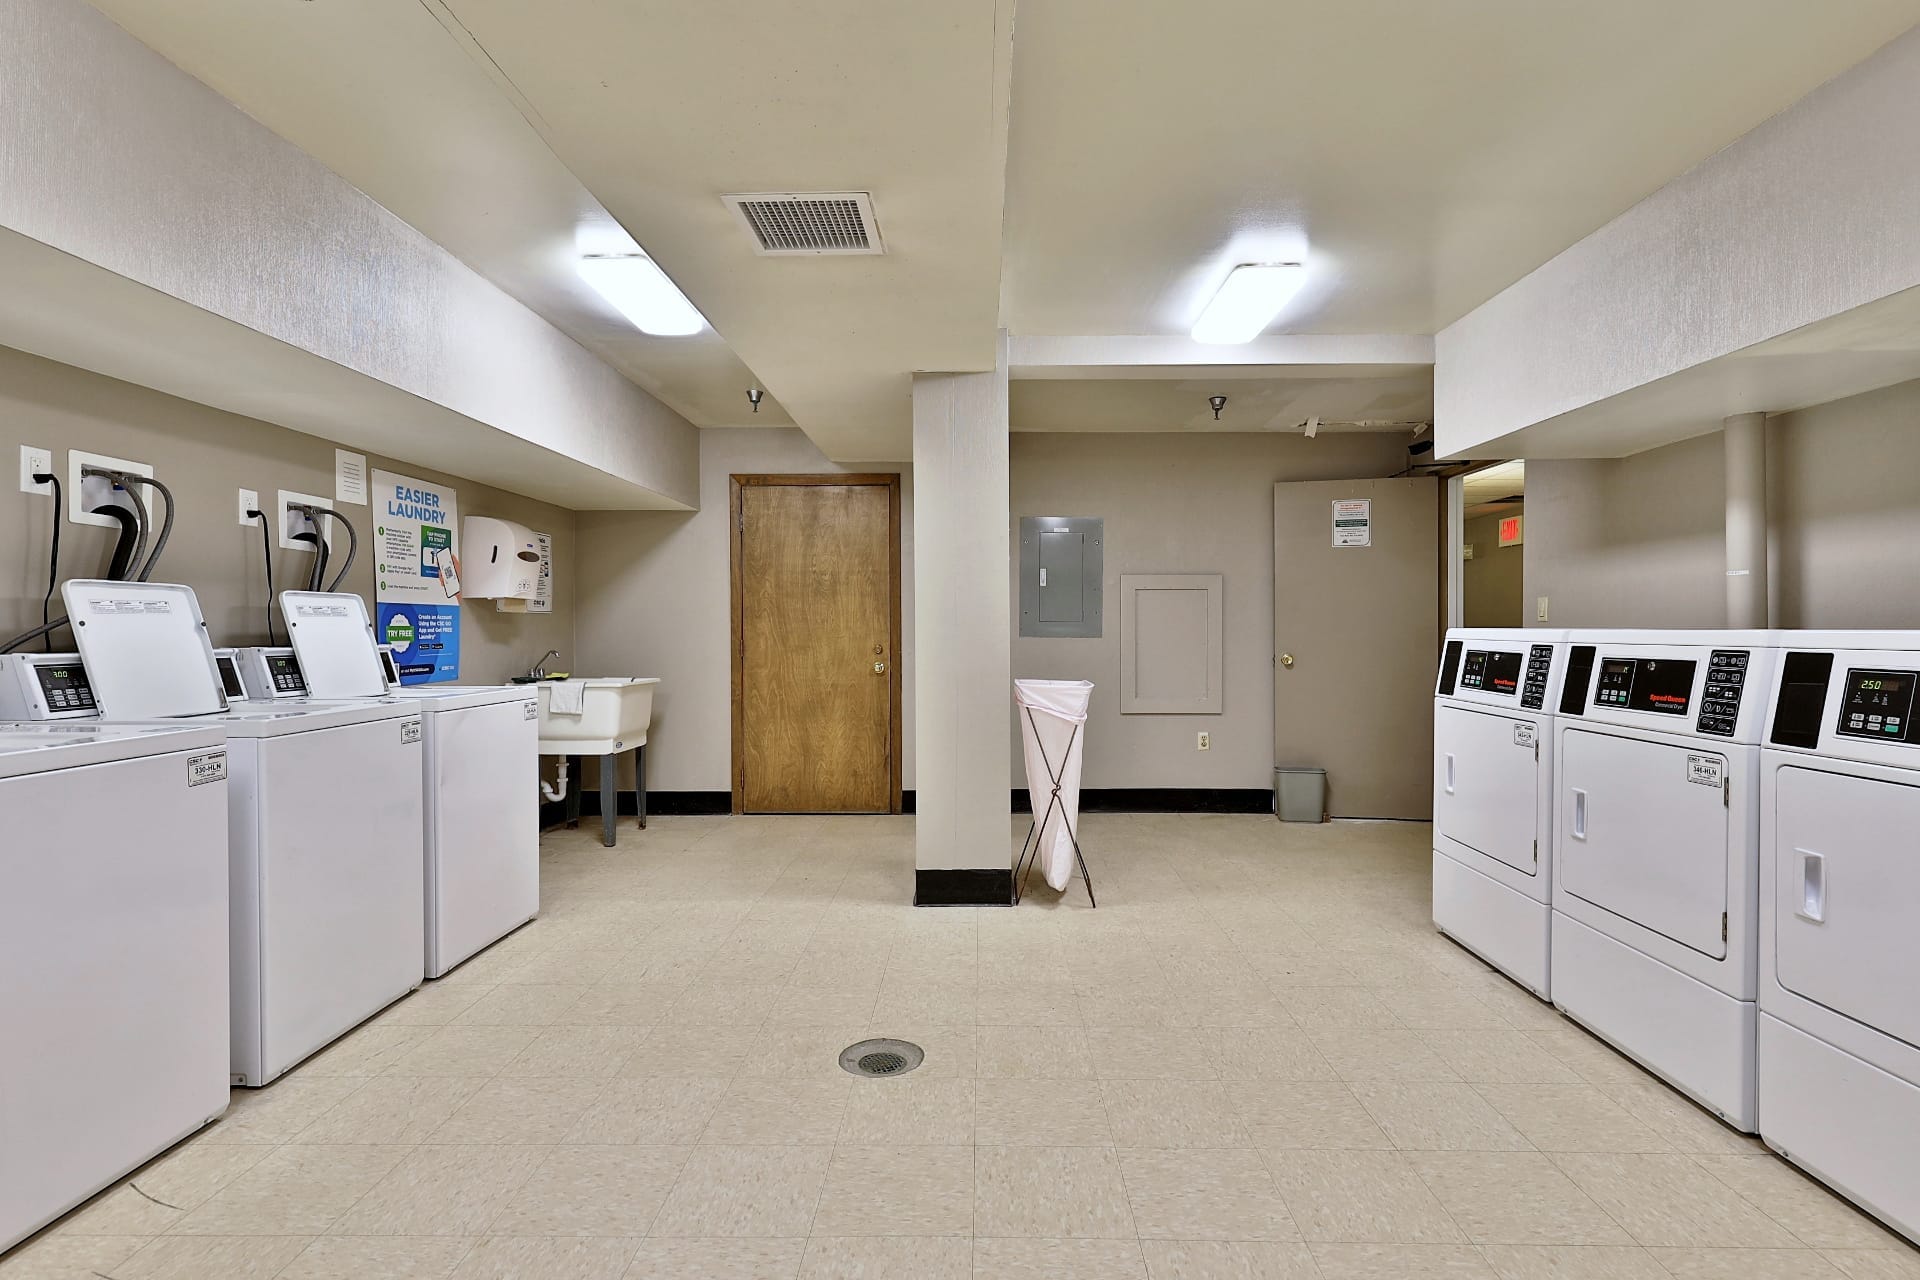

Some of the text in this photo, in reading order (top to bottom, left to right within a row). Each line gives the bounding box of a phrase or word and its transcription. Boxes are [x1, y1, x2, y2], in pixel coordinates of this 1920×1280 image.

[396, 486, 439, 507] EASIER
[388, 501, 445, 524] LAUNDRY
[1501, 518, 1517, 541] EXIT
[388, 630, 398, 638] TRY
[1649, 694, 1686, 703] Speed Queen
